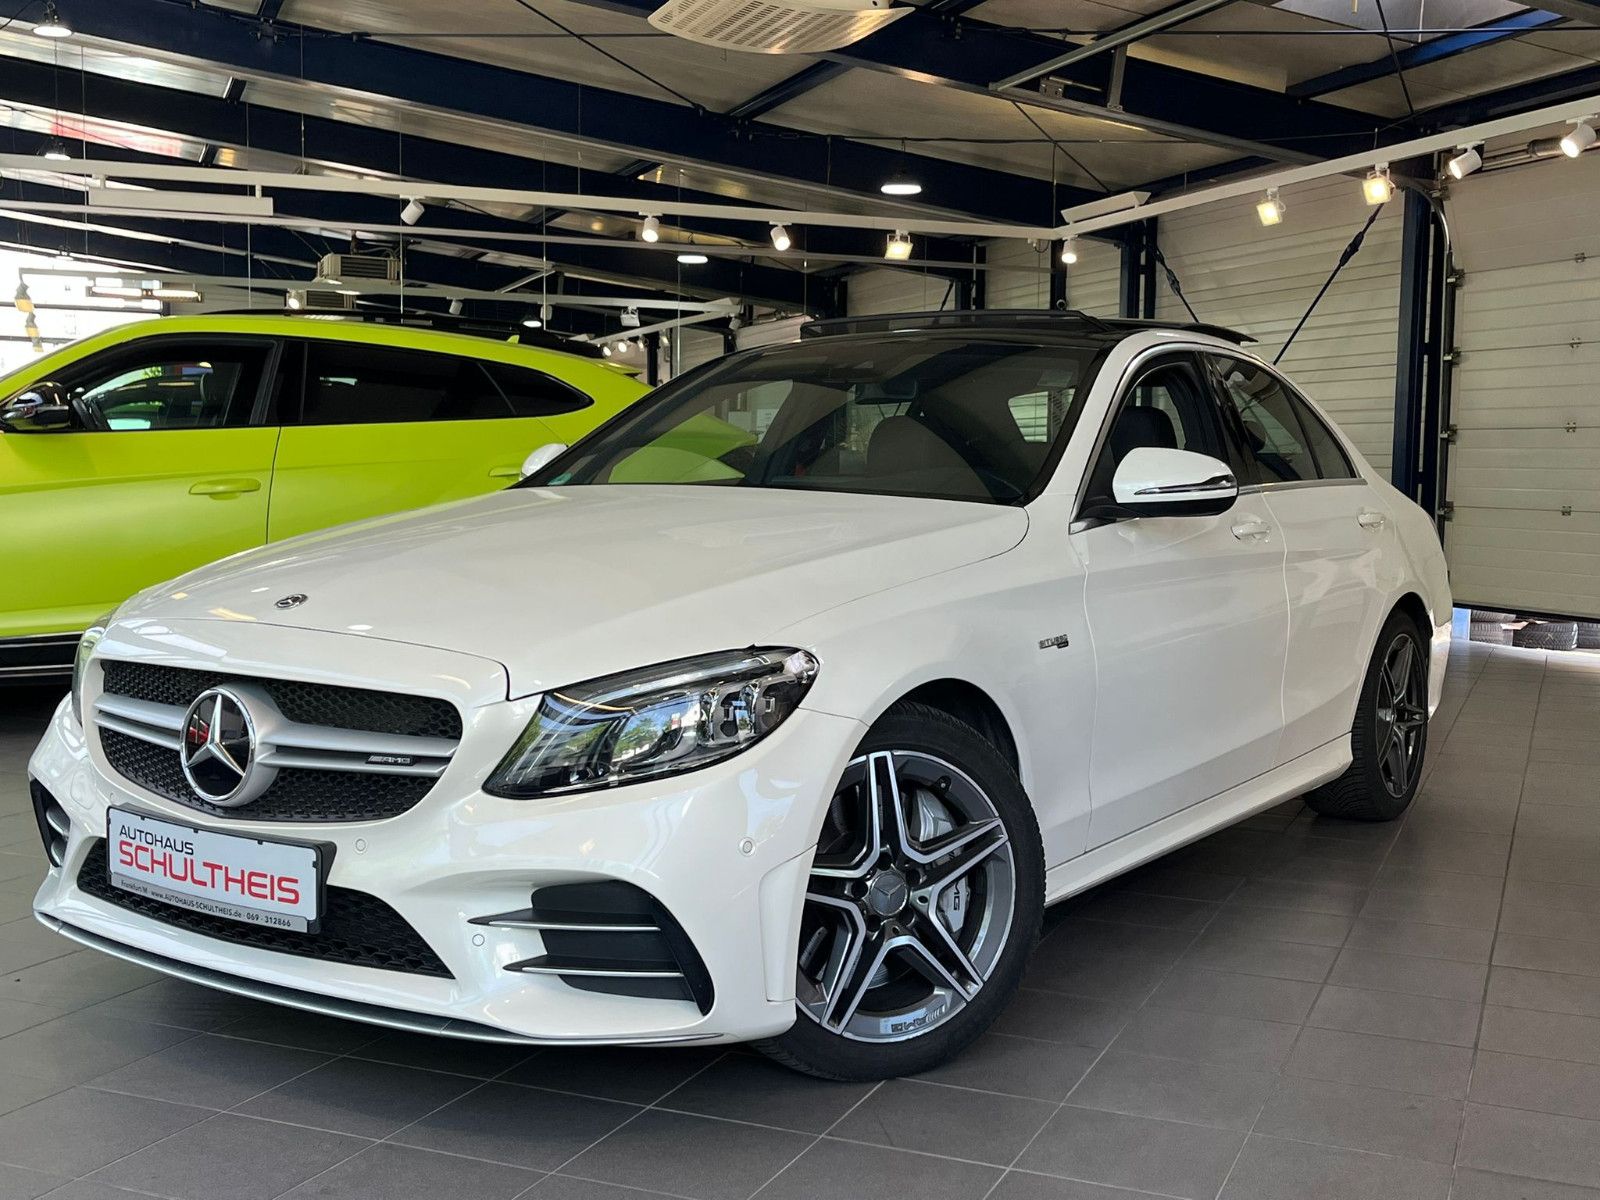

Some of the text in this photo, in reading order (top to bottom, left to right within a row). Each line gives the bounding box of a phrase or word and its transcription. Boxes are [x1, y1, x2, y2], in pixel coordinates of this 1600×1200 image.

[119, 824, 194, 856] AUTOHAUS
[119, 839, 300, 905] SCHULTHEIS
[246, 911, 260, 922] 069
[264, 915, 292, 928] 312866
